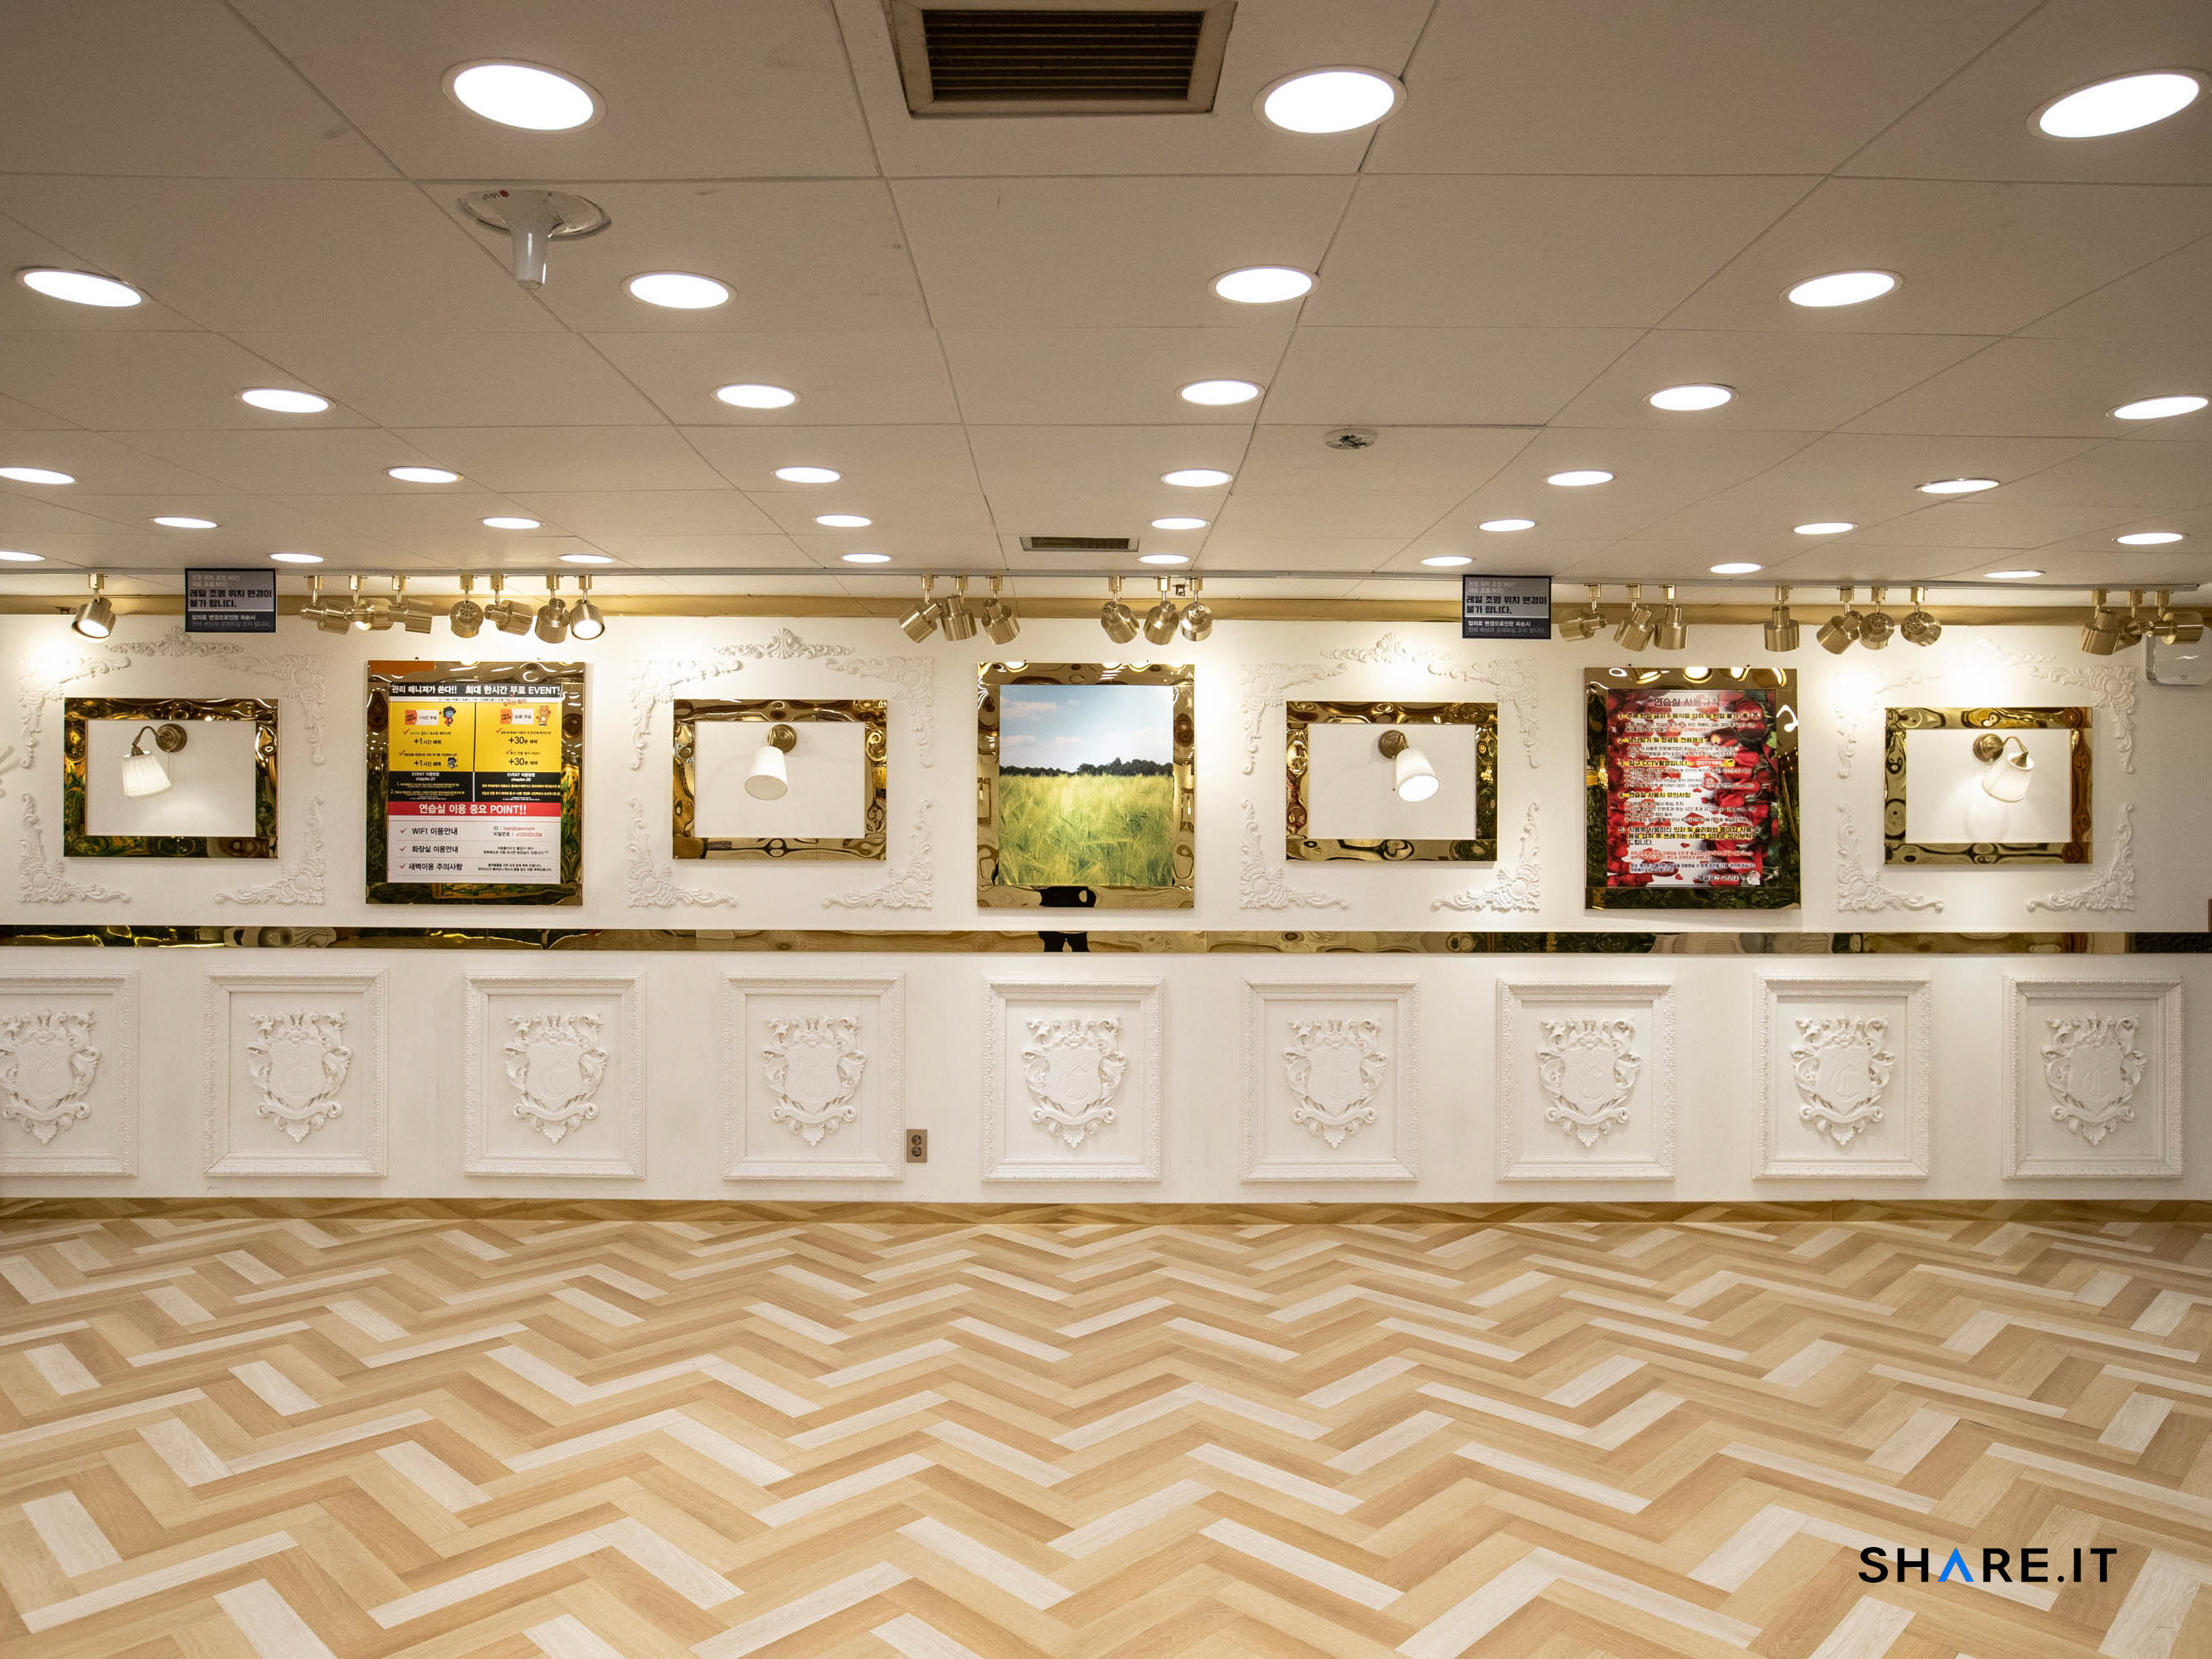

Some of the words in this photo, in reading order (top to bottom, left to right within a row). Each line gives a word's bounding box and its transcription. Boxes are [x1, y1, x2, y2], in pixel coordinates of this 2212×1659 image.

[190, 589, 206, 598] 레일
[210, 589, 226, 598] 조명
[229, 589, 245, 598] 위치
[248, 589, 272, 598] 변경이
[190, 599, 206, 608] 불가
[1466, 596, 1482, 605] 레일
[1485, 596, 1501, 605] 조명
[1505, 596, 1519, 605] 위치
[1523, 596, 1547, 605] 변경이
[1466, 606, 1482, 614] 불가
[1485, 606, 1512, 614] 합니다.
[391, 685, 406, 693] 관리
[408, 685, 436, 693] 매니저가
[438, 685, 457, 694] 쓴다!!
[465, 685, 481, 694] 최대
[484, 685, 508, 694] 한시간
[510, 685, 527, 694] 무료
[1654, 698, 1680, 708] 연습실
[419, 804, 445, 815] 연습실
[450, 804, 467, 815] 이용
[469, 804, 488, 815] 중요
[490, 804, 527, 815] POINT!!
[409, 863, 435, 871] 새벽이용
[437, 863, 463, 871] 주의사항
